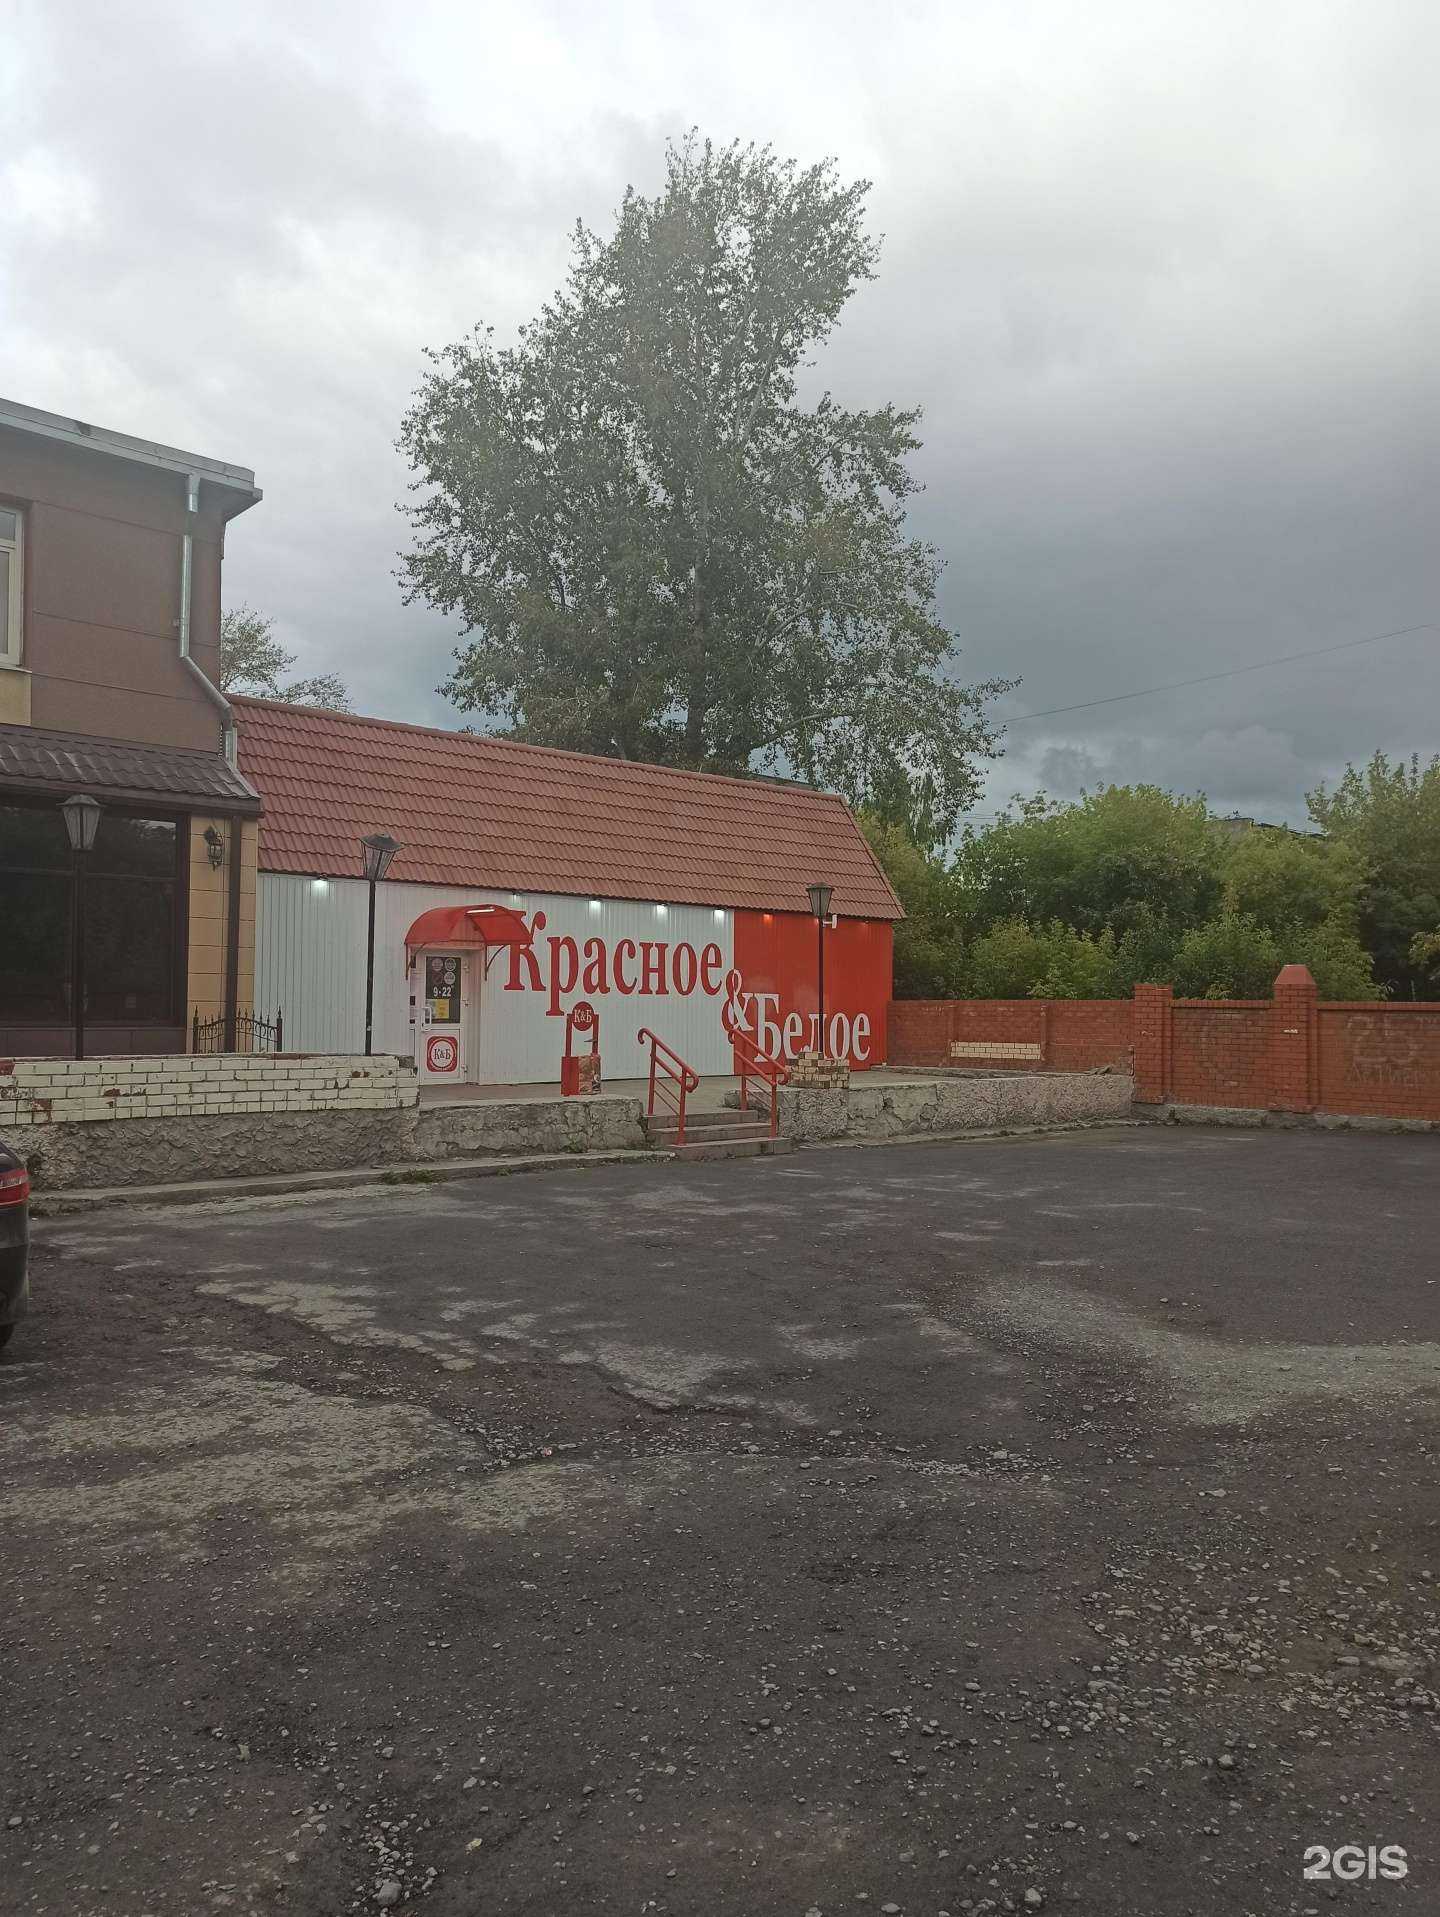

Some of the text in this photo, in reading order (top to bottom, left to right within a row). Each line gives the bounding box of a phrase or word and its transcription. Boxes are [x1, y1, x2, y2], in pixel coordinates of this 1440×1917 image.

[503, 910, 723, 1017] Красное
[574, 1009, 592, 1023] К&Б
[753, 992, 871, 1063] Белое
[434, 1048, 451, 1060] К&Б
